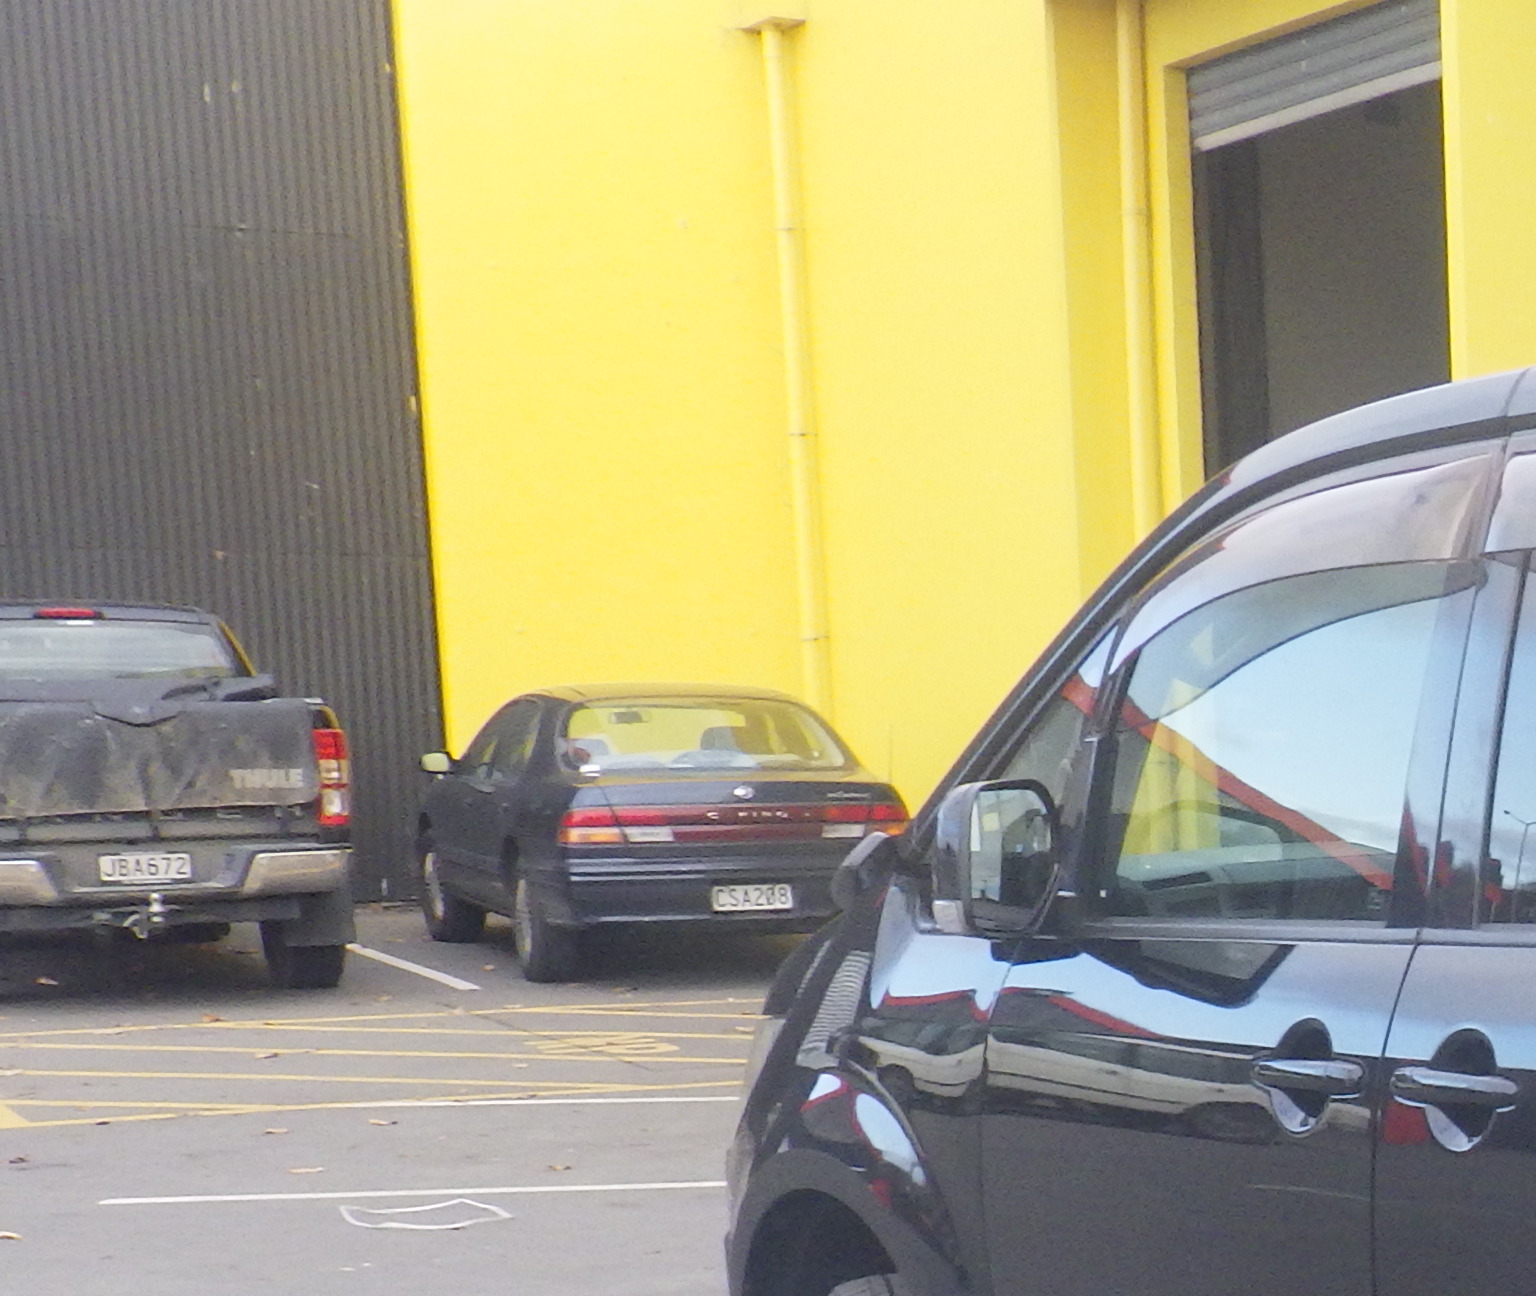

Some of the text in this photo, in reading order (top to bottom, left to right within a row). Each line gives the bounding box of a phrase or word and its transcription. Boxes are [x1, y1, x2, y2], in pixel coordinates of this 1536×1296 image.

[229, 768, 303, 789] THULE
[105, 856, 188, 878] JBA672
[715, 887, 789, 907] CSA208
